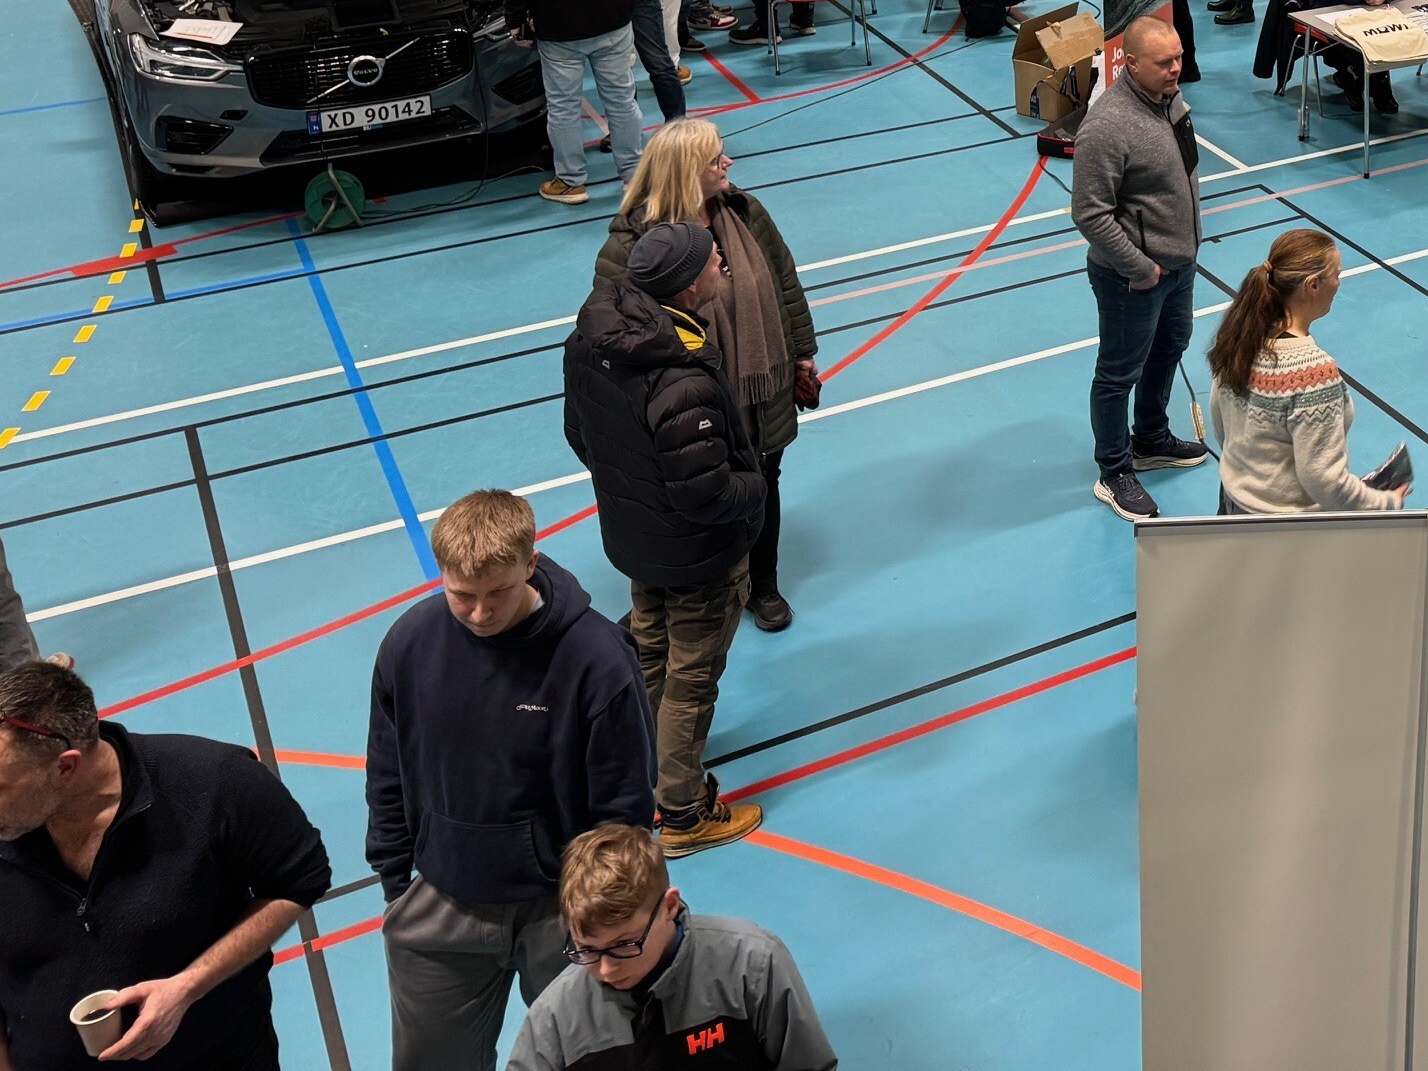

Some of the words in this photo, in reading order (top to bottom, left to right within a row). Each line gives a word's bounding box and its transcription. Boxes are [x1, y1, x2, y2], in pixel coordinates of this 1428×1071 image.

[327, 111, 355, 128] XD
[365, 99, 425, 123] 90142
[687, 1022, 724, 1054] HH
